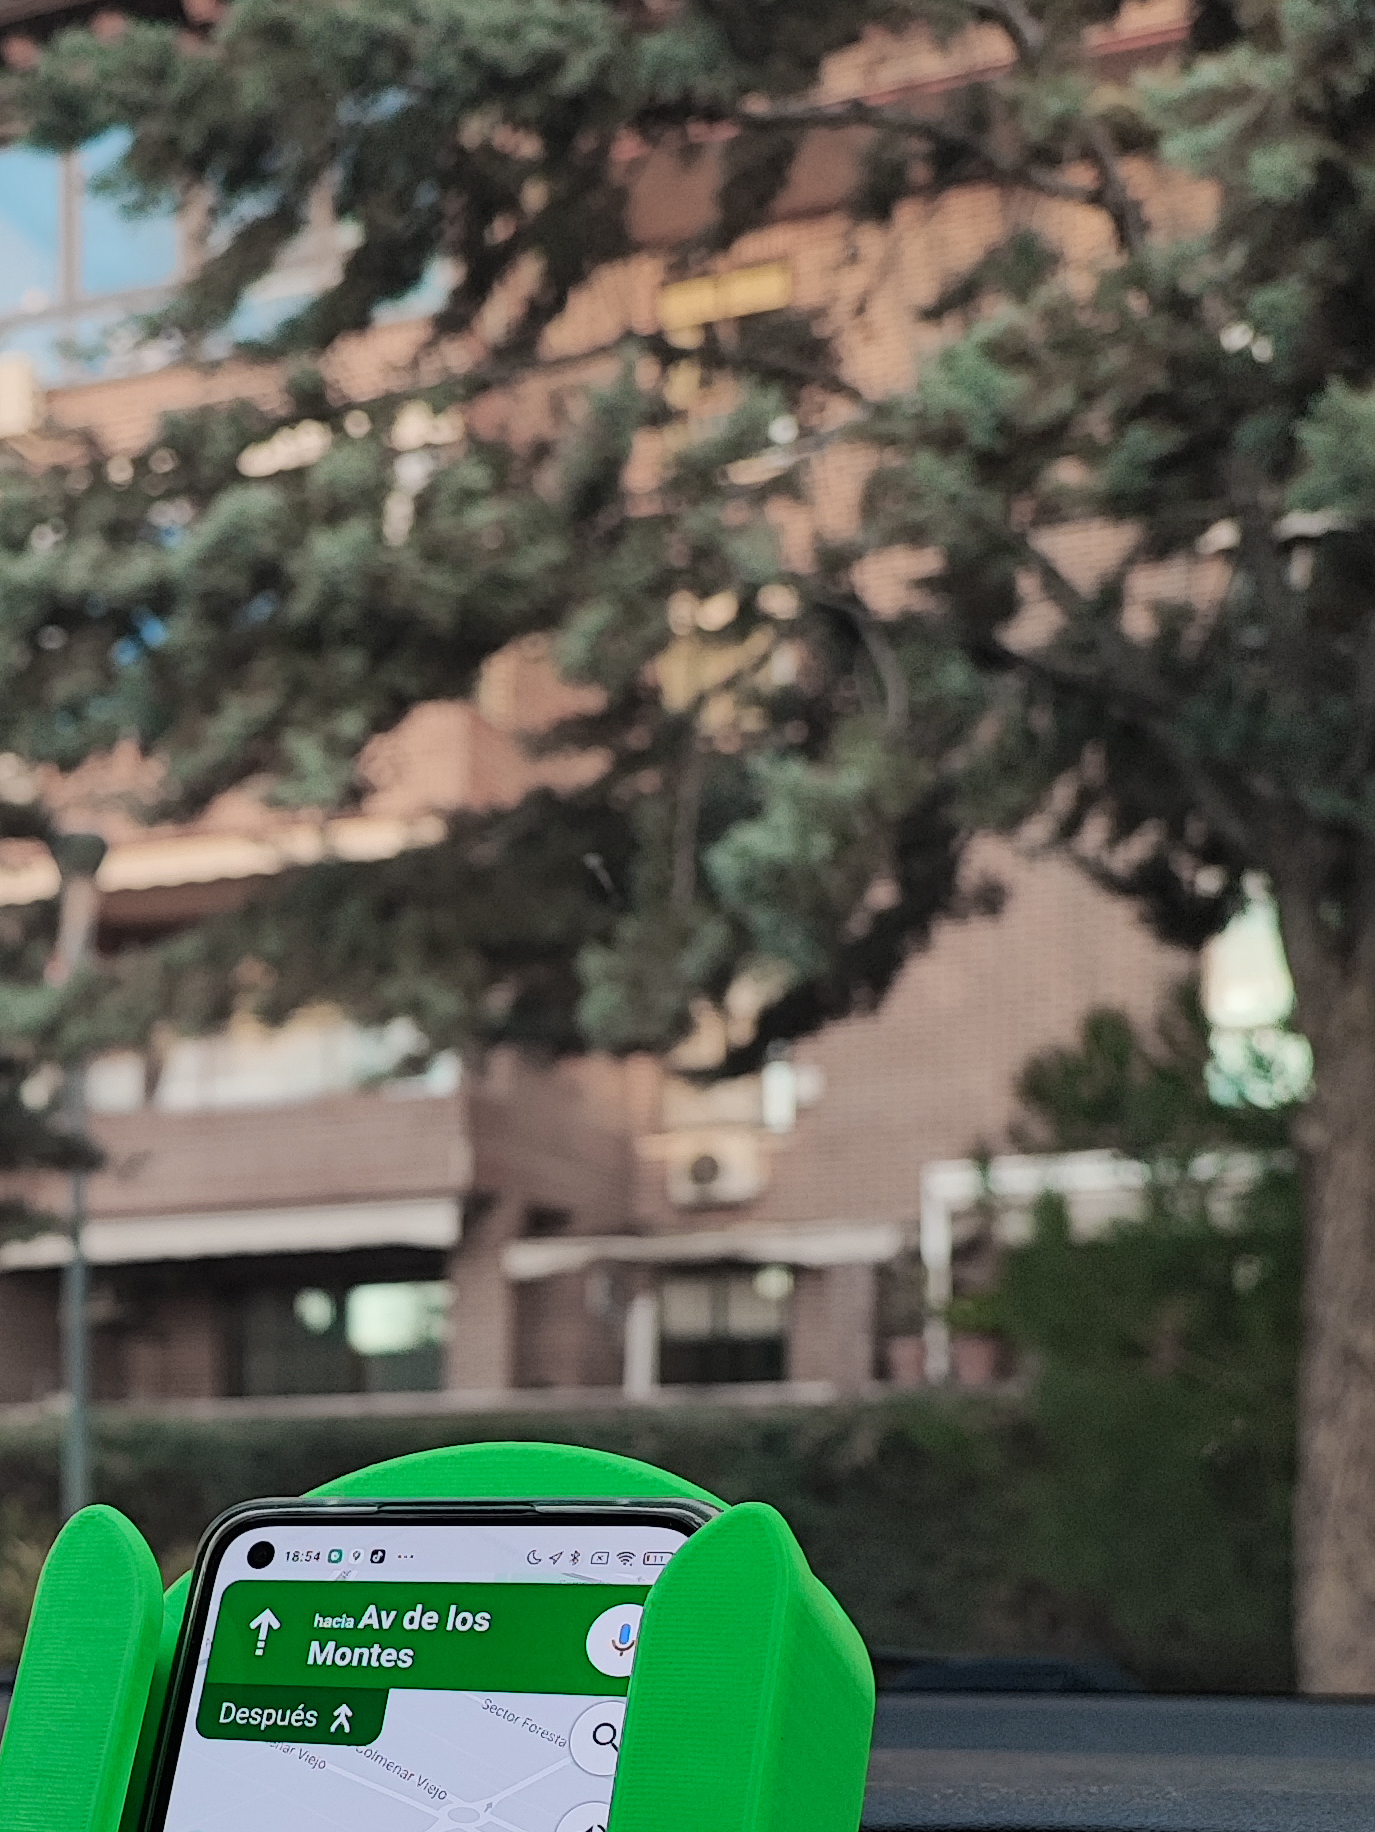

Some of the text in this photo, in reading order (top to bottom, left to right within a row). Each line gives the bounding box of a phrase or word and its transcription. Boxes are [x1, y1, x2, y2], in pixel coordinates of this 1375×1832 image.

[285, 1551, 321, 1562] 18:54
[313, 1604, 491, 1632] hacia Av de los
[307, 1641, 414, 1669] Montes
[219, 1702, 319, 1731] Después
[482, 1698, 568, 1748] Sector Foresta
[298, 1748, 326, 1770] Viejo
[417, 1776, 447, 1801] Viejo
